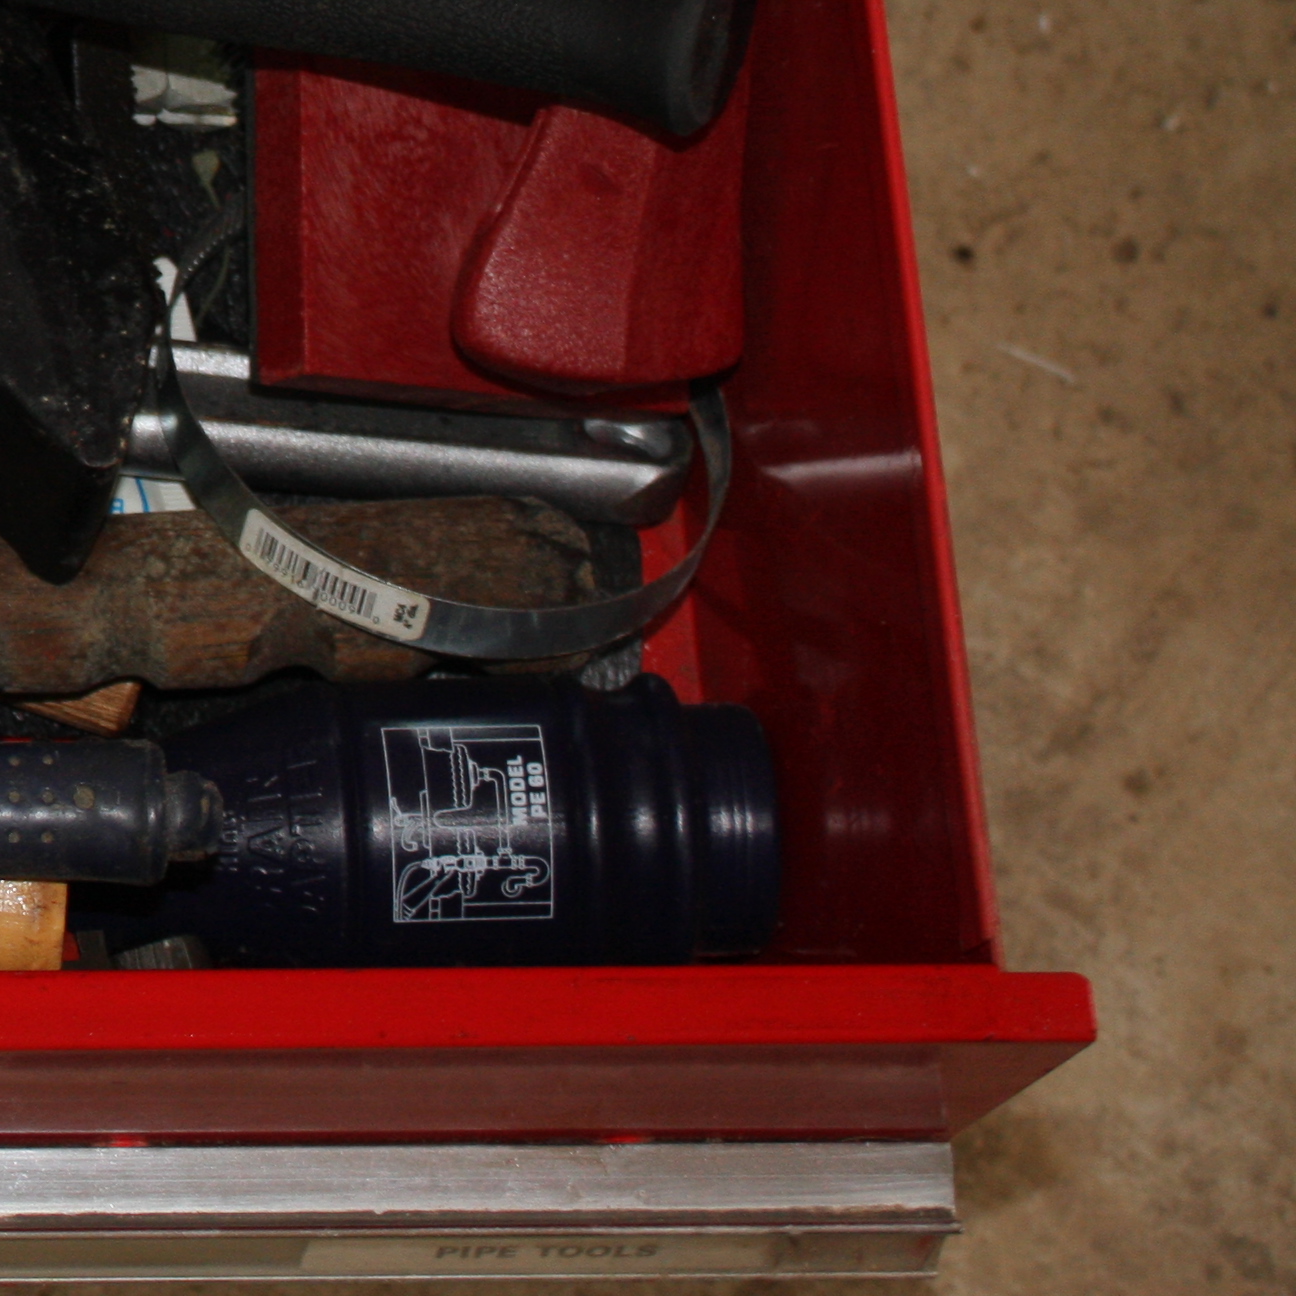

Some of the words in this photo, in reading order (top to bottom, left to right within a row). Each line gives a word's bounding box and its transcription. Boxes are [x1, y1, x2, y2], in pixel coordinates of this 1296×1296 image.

[506, 755, 527, 826] MODEL
[529, 792, 547, 818] PE
[435, 1244, 517, 1260] PIPE
[538, 1243, 659, 1260] TOOLS
